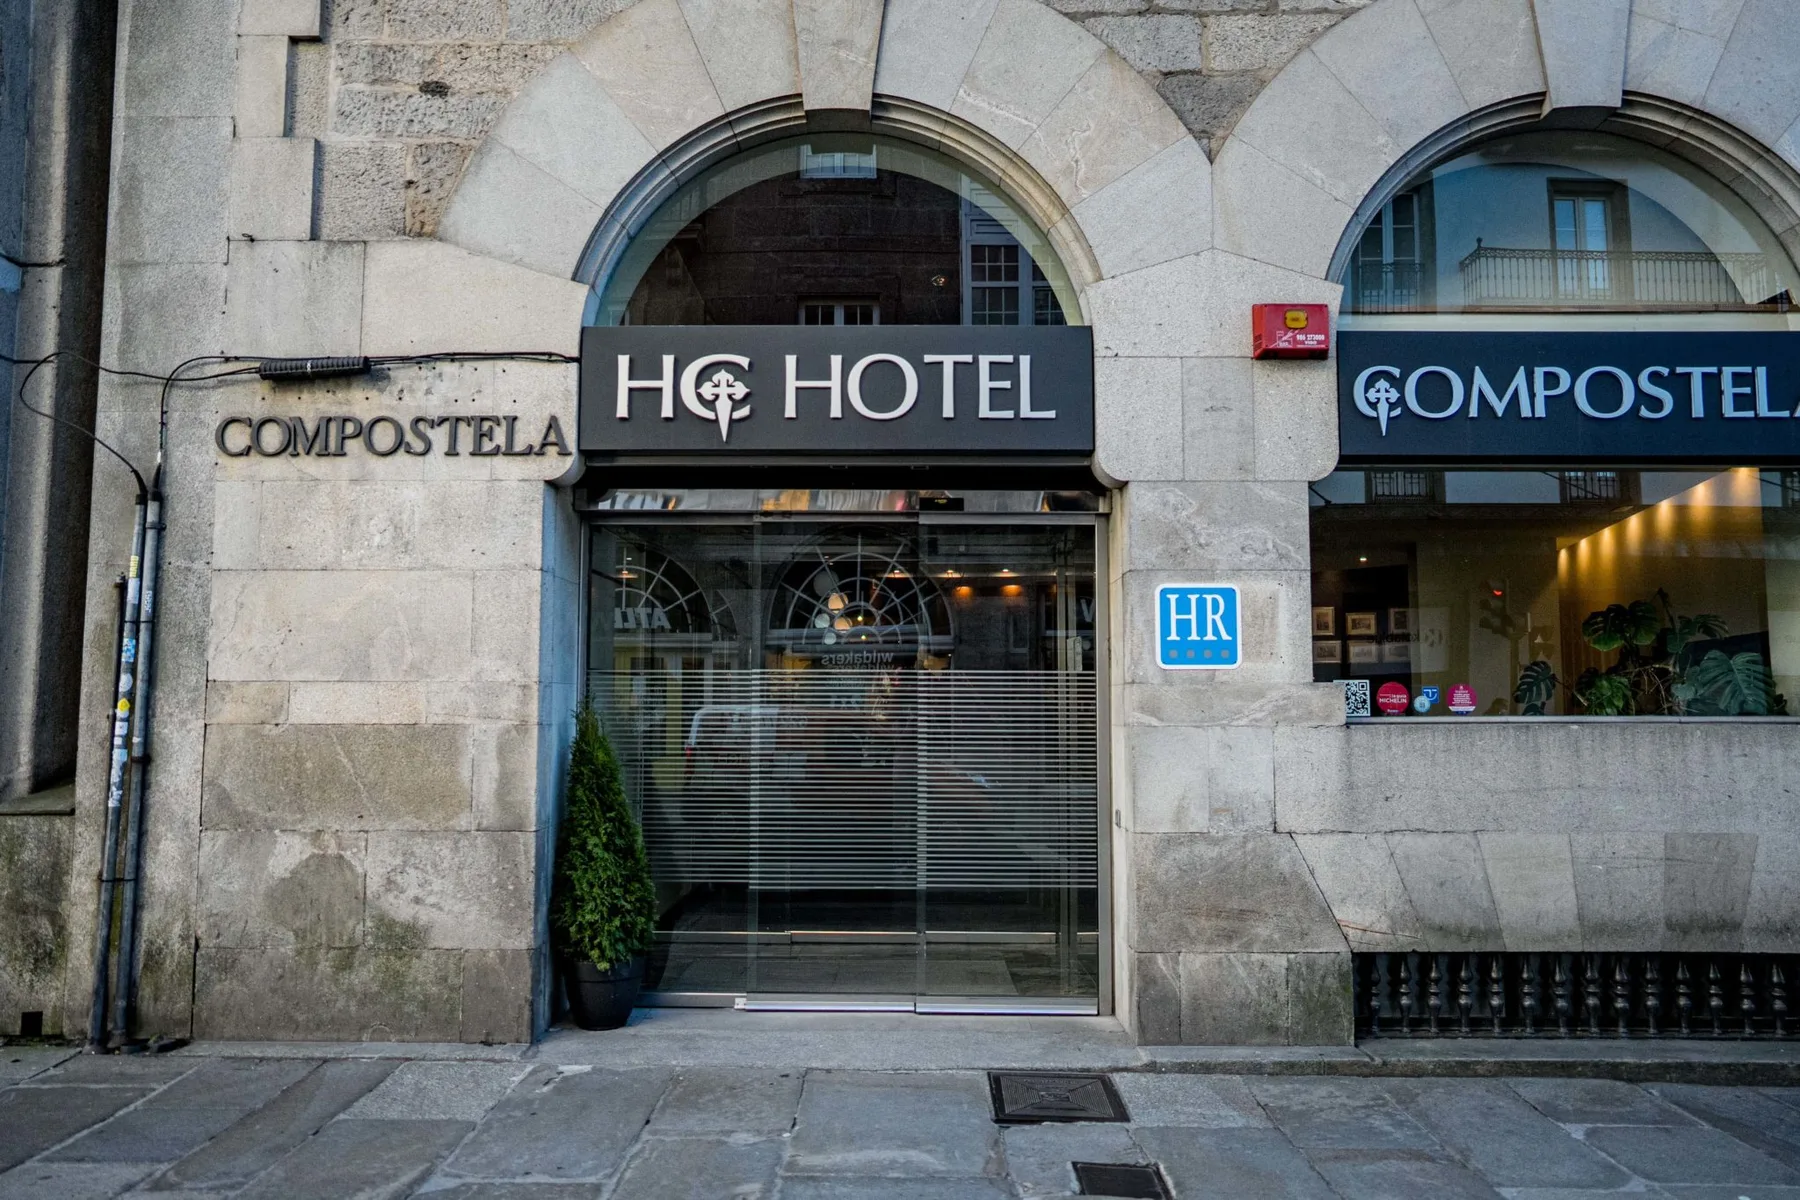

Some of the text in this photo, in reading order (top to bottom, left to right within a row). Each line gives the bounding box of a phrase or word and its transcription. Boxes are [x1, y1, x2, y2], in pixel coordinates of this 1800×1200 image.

[616, 353, 1056, 424] HC HOTEL
[1353, 364, 1800, 419] COMPOSTEL
[214, 414, 573, 457] COMPOSTELA
[1165, 594, 1233, 641] HR
